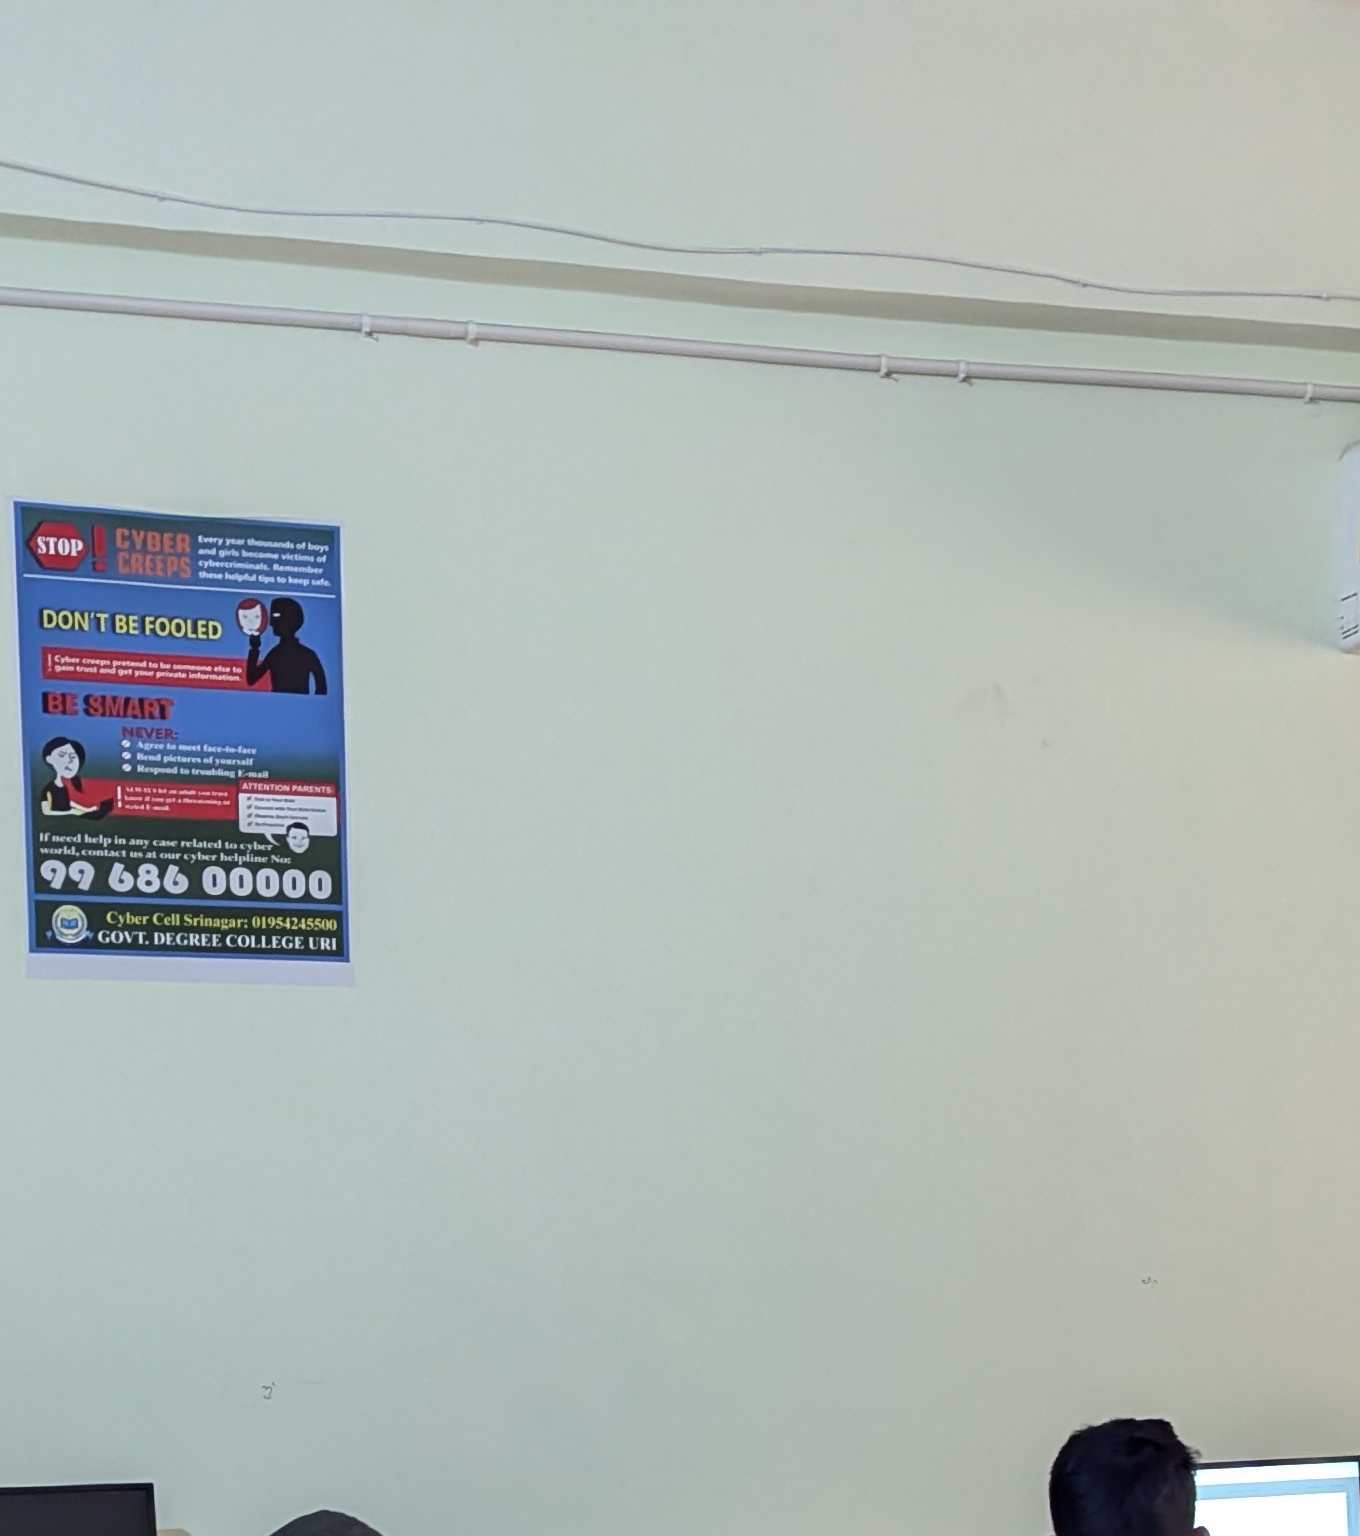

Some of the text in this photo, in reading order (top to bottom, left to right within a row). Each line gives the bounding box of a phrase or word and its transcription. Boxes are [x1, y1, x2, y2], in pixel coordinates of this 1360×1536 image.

[36, 535, 84, 557] STOP
[115, 528, 192, 554] CYBER
[197, 535, 330, 553] Every year thousands of boys
[117, 551, 193, 579] CREEPS
[198, 547, 217, 556] and
[219, 548, 240, 558] girls
[281, 552, 315, 562] victims
[317, 555, 327, 563] of
[198, 571, 223, 580] these
[288, 576, 310, 587] keep
[273, 563, 324, 574] Remember
[115, 614, 139, 635] BE
[144, 615, 223, 640] FOOLED
[53, 654, 80, 664] Cyber
[82, 657, 111, 667] creeps
[148, 661, 159, 669] to
[44, 692, 176, 720] BE SMART
[166, 742, 177, 750] to
[179, 766, 190, 775] to
[203, 755, 214, 765] of
[241, 782, 332, 794] ATTENTION PARENTS
[39, 832, 274, 855] If need help in any case related to cyber
[39, 845, 80, 857] world,
[81, 847, 127, 858] contact
[129, 850, 144, 859] us
[144, 850, 157, 860] at
[159, 851, 182, 861] our
[183, 851, 218, 864] cyber
[219, 852, 269, 866] helpline
[40, 859, 332, 900] 99 686 00000
[105, 910, 338, 932] Cyber Cell Srinagar: 01954245500
[97, 929, 338, 951] GOVT. DEGREE COLLEGE URI
